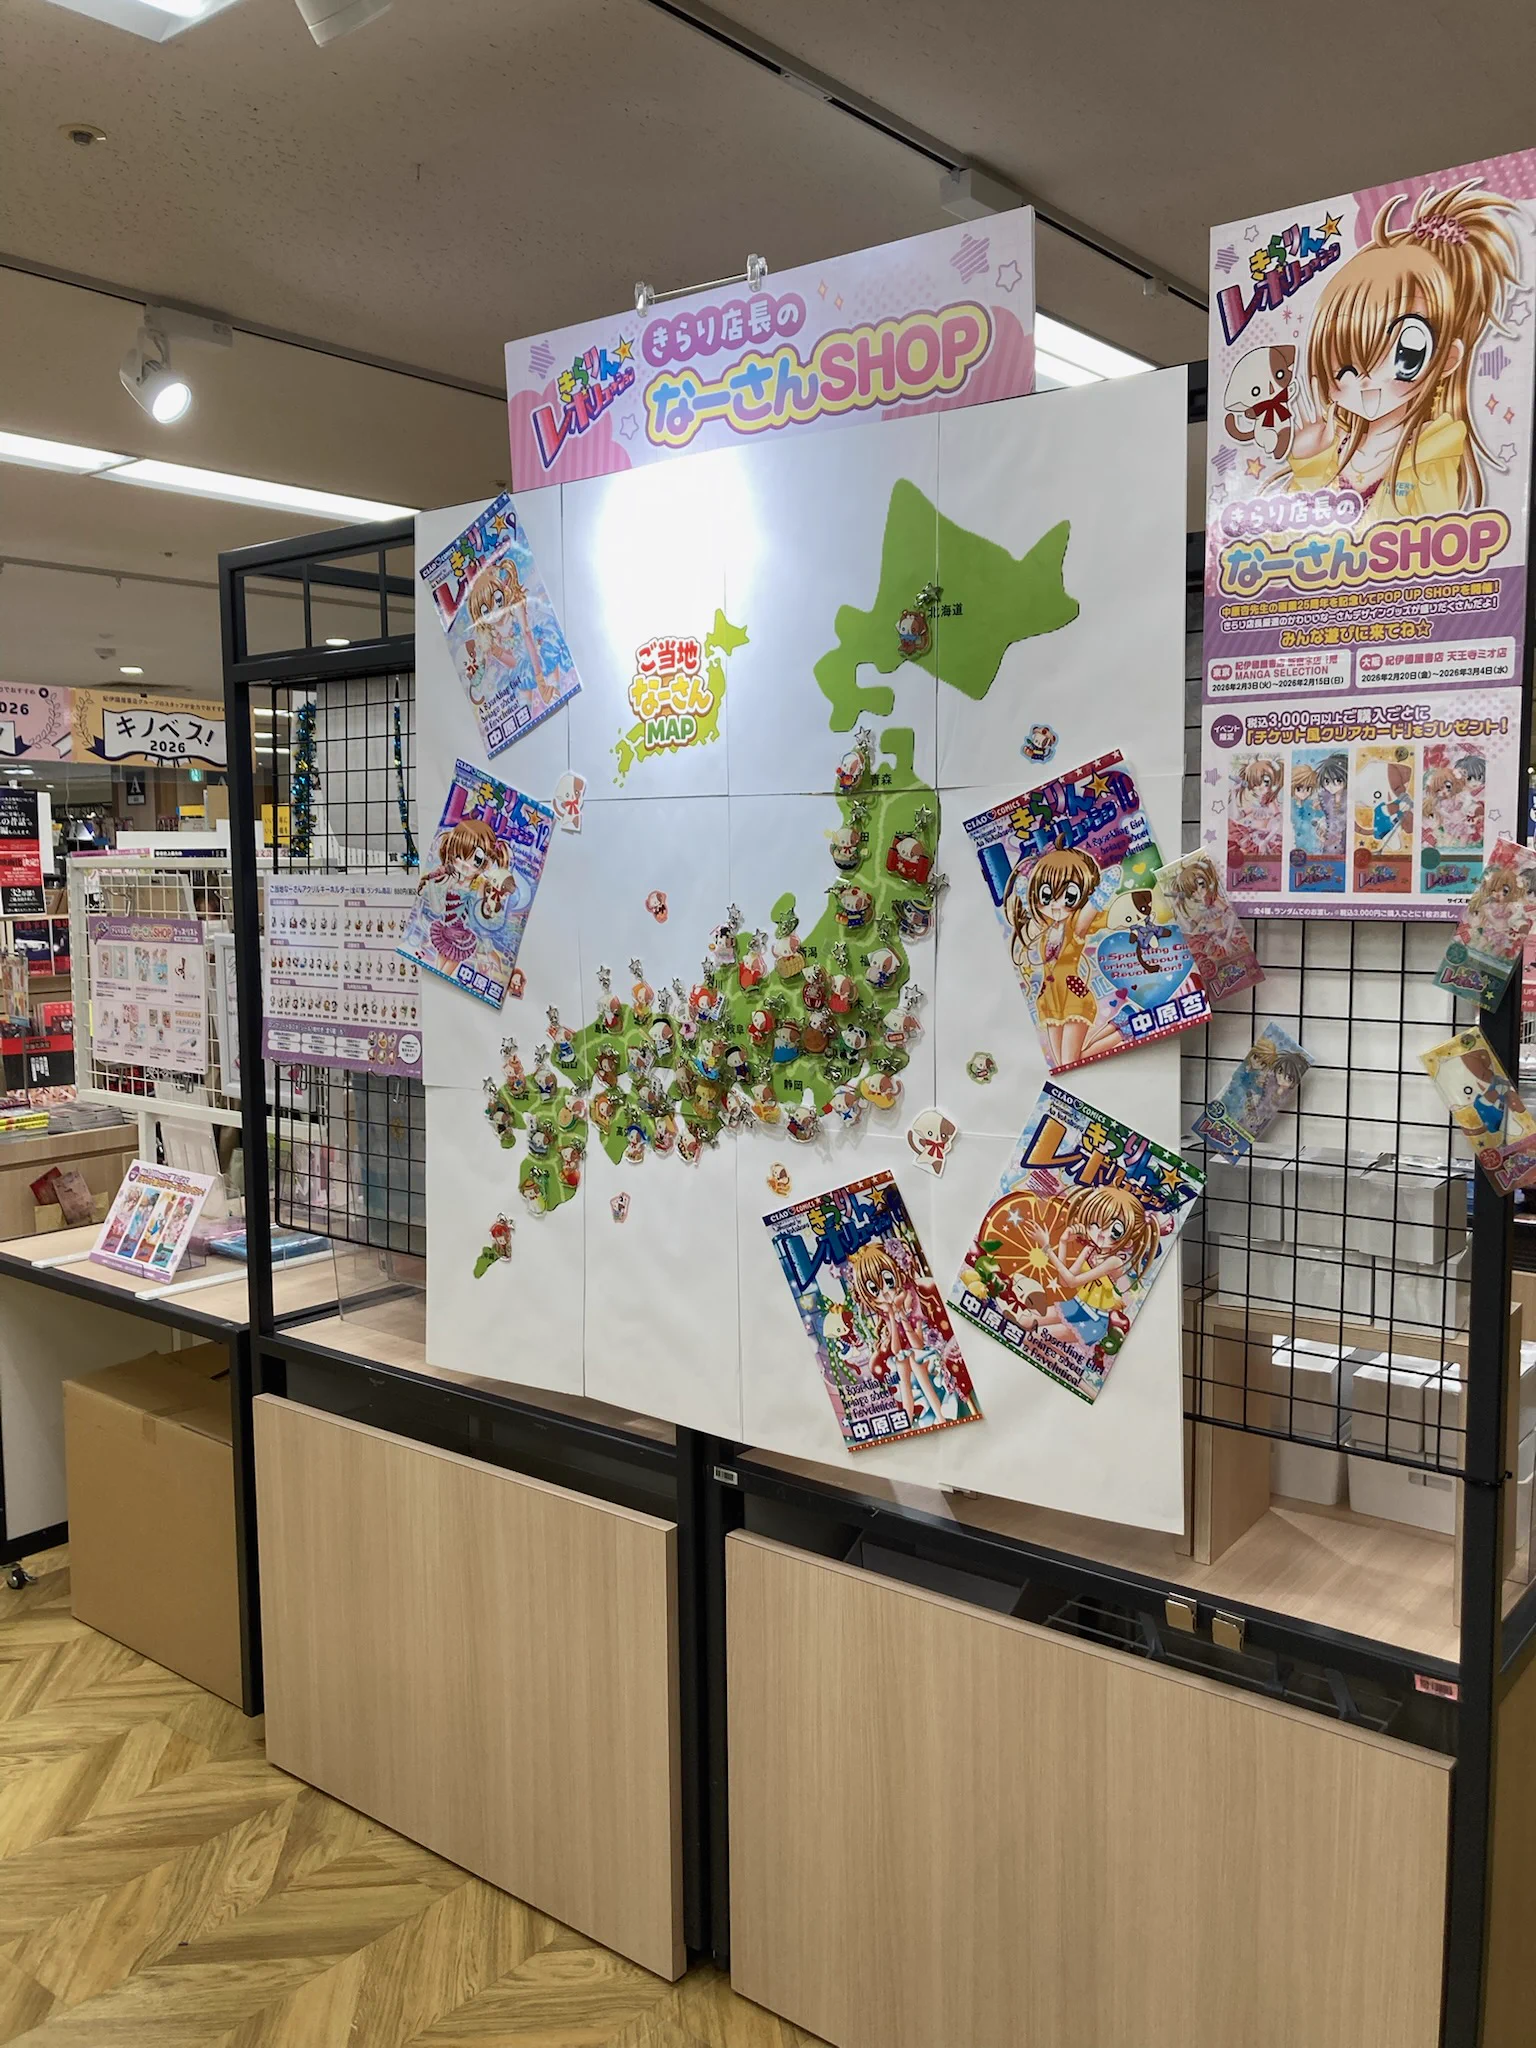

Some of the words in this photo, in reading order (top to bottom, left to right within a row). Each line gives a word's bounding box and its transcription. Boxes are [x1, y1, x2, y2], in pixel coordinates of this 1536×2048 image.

[651, 302, 800, 354] きらり店長の
[652, 316, 980, 436] なーさんSHOP
[1230, 499, 1355, 532] きらり店長の
[1227, 520, 1500, 587] なーさんSHOP
[1404, 588, 1422, 602] UP
[927, 603, 964, 619] 北海道
[638, 640, 698, 672] ご当地
[1385, 652, 1444, 666] 紀伊國屋書店
[1447, 647, 1508, 663] 天王寺ミオ店
[1235, 669, 1271, 681] MANGA
[1274, 665, 1329, 678] SELECTION
[1361, 666, 1509, 682] 2026年2月20日(金)～2026年3月4日(水)
[631, 675, 710, 715] なーさん
[116, 716, 214, 746] キノベス!
[648, 717, 695, 744] MAP
[1214, 725, 1240, 733] イベント
[1246, 707, 1431, 728] 税込3,000円以上ご購入ごとに
[1246, 718, 1508, 745] 「チケット風クリアカード」をプレゼント!
[150, 740, 186, 753] 2026
[871, 773, 892, 786] 青森
[965, 816, 988, 831] CIAO
[996, 800, 1021, 816] COMICS
[459, 965, 504, 1001] 中原杏
[1131, 992, 1203, 1033] 中原杏
[783, 1079, 803, 1092] 静岡
[1050, 1088, 1074, 1105] CIAO
[1081, 1106, 1107, 1123] COMICS
[769, 1210, 789, 1222] CIAO
[962, 1293, 1025, 1345] 中原杏
[1040, 1327, 1085, 1365] Sparkling
[852, 1411, 909, 1440] 中原杏
